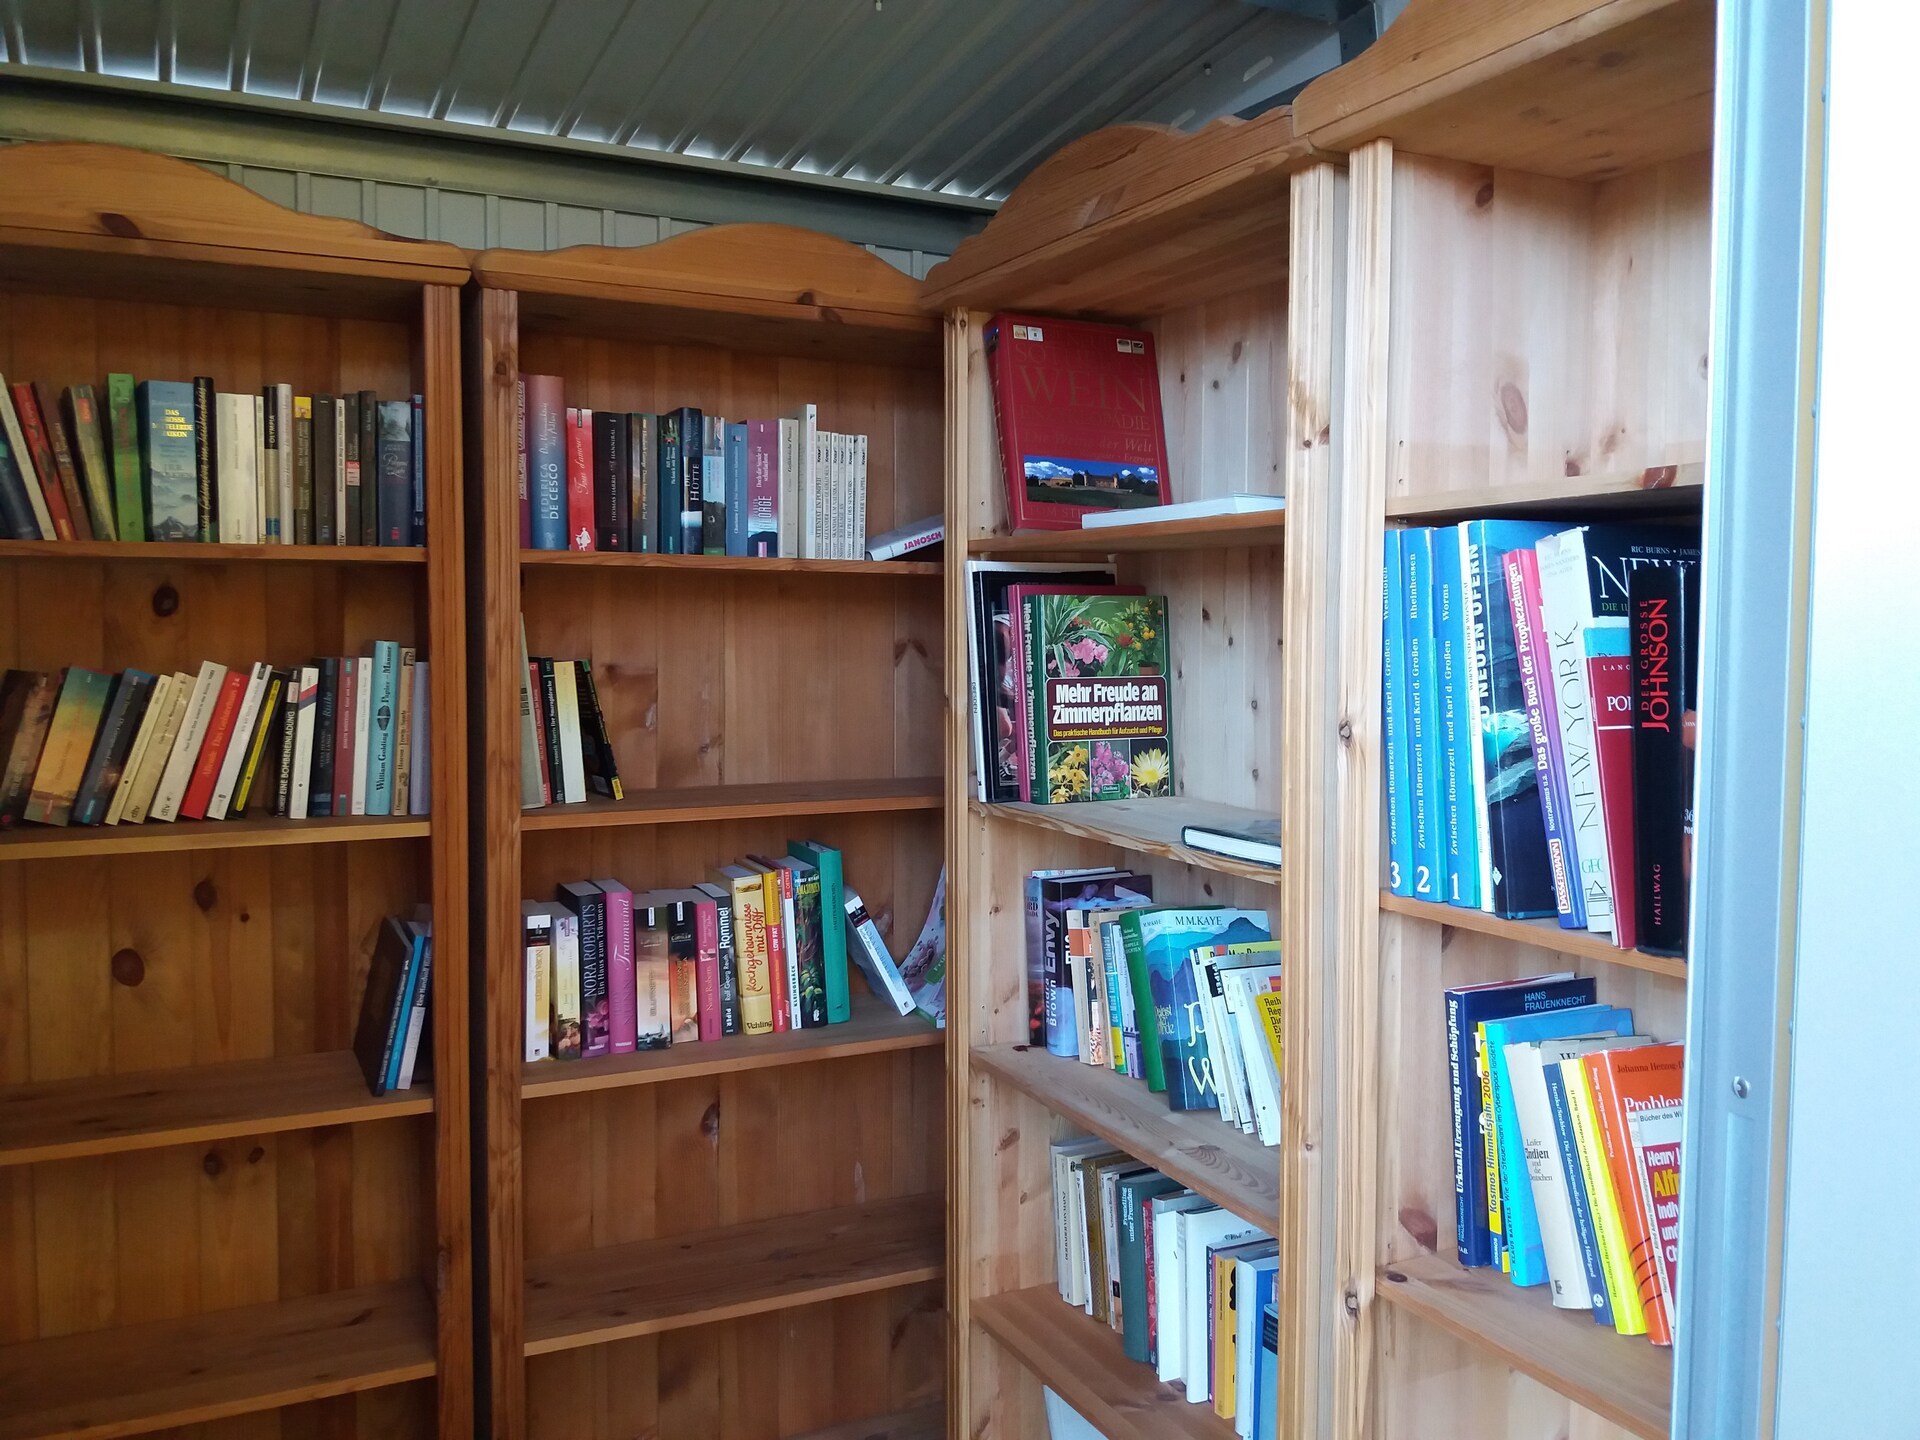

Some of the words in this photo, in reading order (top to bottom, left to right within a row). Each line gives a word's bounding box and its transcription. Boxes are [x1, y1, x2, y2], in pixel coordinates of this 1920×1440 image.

[1018, 364, 1146, 413] WEIN
[1124, 438, 1152, 453] Welt
[540, 463, 549, 519] FEDERICA
[548, 463, 558, 501] CESCO
[549, 505, 559, 520] DE
[815, 501, 822, 509] IN
[903, 531, 942, 551] JANOSCH
[1631, 546, 1644, 554] RIC
[1646, 546, 1670, 555] BURNS
[1408, 553, 1418, 619] Rheinhessen
[1468, 543, 1485, 616] UFERN
[1023, 602, 1033, 632] Mehr
[1442, 584, 1451, 622] Worms
[1508, 562, 1531, 653] Prophezeiungen
[1602, 602, 1618, 611] DIE
[1640, 600, 1649, 670] GROSSE
[382, 647, 393, 675] Männer
[1025, 633, 1034, 672] Freude
[1384, 639, 1392, 678] Großen
[1411, 638, 1420, 677] Großen
[1443, 640, 1452, 678] Großen
[1475, 623, 1487, 699] NEUEN
[1522, 655, 1534, 675] der
[1642, 599, 1670, 732] JOHNSON
[381, 682, 391, 704] Papier
[1027, 673, 1034, 688] an
[1056, 683, 1091, 704] Mehr
[1093, 682, 1140, 703] Freude
[1142, 684, 1158, 701] an
[1385, 682, 1392, 691] d.
[1412, 681, 1420, 690] d.
[1444, 682, 1453, 692] d.
[1528, 676, 1541, 707] Buch
[1554, 621, 1585, 736] YORK
[1385, 695, 1393, 714] Karl
[1412, 694, 1421, 715] Karl
[1445, 695, 1454, 718] Karl
[1641, 678, 1650, 711] DER
[212, 732, 221, 747] Das
[218, 689, 237, 730] Geisterhaus
[1052, 702, 1163, 726] Zimmerpflanzen
[1386, 718, 1394, 737] und
[1413, 719, 1422, 738] und
[1535, 709, 1548, 744] große
[280, 711, 295, 778] BOMBENEINLADUNG
[1028, 689, 1037, 781] Zimmerpflanzen
[1063, 729, 1088, 738] praktische
[1089, 728, 1111, 736] Handbuch
[1119, 727, 1139, 735] Aufzucht
[1148, 726, 1162, 734] Pflege
[1446, 722, 1455, 742] und
[377, 734, 389, 762] Golding
[1536, 746, 1549, 771] Das
[375, 763, 386, 792] William
[1387, 742, 1396, 794] Römerzeit
[1414, 743, 1424, 796] Römerzeit
[1447, 748, 1457, 802] Römerzeit
[279, 779, 288, 794] EINE
[1568, 741, 1599, 831] NEW
[1390, 798, 1398, 846] Zwischen
[1544, 787, 1556, 832] Nostradamus
[1417, 801, 1426, 849] Zwischen
[1449, 806, 1459, 856] Zwischen
[1391, 861, 1401, 888] 3
[1417, 864, 1431, 893] 2
[1452, 872, 1460, 901] 1
[1652, 863, 1662, 926] HALLWAG
[582, 903, 596, 961] ROBERTS
[613, 898, 631, 971] Traumwind
[717, 907, 731, 949] Rommel
[1045, 909, 1060, 974] Envy
[743, 903, 763, 992] Kochgeheimnisse
[755, 935, 765, 953] mit
[535, 949, 543, 970] NORA
[722, 954, 730, 970] Reuth
[535, 970, 543, 1001] ROBERTS
[584, 962, 597, 997] NORA
[705, 966, 713, 992] Roberts
[723, 971, 731, 989] Georg
[1212, 964, 1222, 994] PIPER
[706, 993, 714, 1011] Nora
[723, 989, 731, 1001] Ralf
[1049, 980, 1057, 1027] Brown
[1110, 995, 1118, 1011] Mond
[1524, 991, 1547, 1002] HANS
[1524, 995, 1587, 1012] FRAUENKNECHT
[1447, 999, 1460, 1061] Schöpfung
[1489, 1040, 1498, 1069] landete
[1617, 1063, 1649, 1073] Johanna
[1449, 1062, 1459, 1085] und
[1482, 1070, 1491, 1100] 2006
[1493, 1070, 1504, 1114] Cyberspace
[1451, 1086, 1464, 1148] Urzeugung
[1496, 1114, 1502, 1123] im
[1640, 1112, 1661, 1122] Bücher
[1663, 1111, 1674, 1120] des
[1486, 1101, 1496, 1169] Himmelsjahr
[1499, 1124, 1508, 1171] Steuermann
[1562, 1140, 1571, 1152] Die
[1454, 1148, 1465, 1194] Urknall,
[1647, 1149, 1673, 1169] Henry
[1487, 1172, 1497, 1213] Kosmos
[1566, 1152, 1581, 1207] Edelsteinmedizin
[1506, 1207, 1514, 1238] BARTELS
[1576, 1207, 1584, 1218] der
[1579, 1219, 1589, 1245] heiligen
[1585, 1245, 1596, 1278] Hildegard
